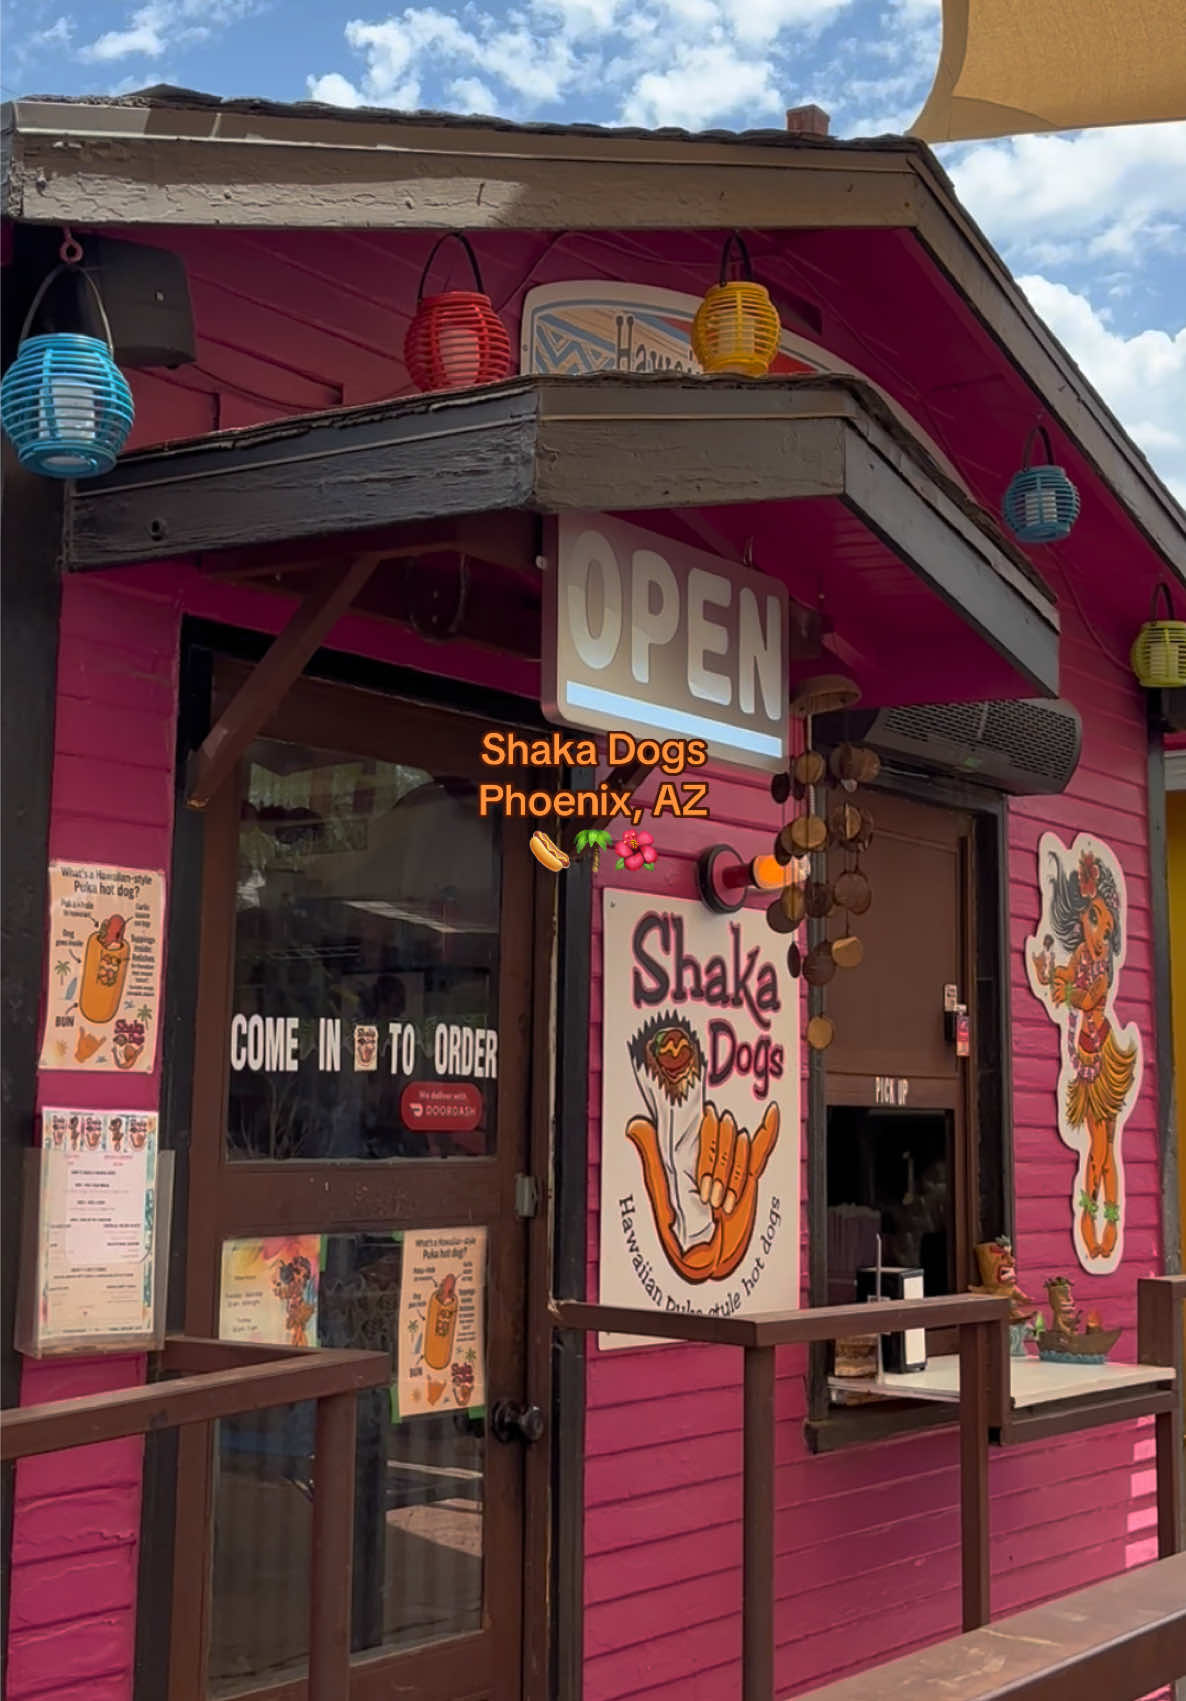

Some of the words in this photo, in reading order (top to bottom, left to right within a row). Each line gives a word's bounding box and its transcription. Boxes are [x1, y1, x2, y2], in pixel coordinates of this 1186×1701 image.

[567, 530, 782, 721] OPEN
[632, 911, 782, 1031] Shaka
[231, 1014, 299, 1071] COME
[319, 1018, 341, 1072] IN
[389, 1022, 416, 1076] TO
[434, 1023, 498, 1079] ORDER
[708, 1018, 784, 1101] Dogs
[425, 1104, 477, 1117] DOORDASH
[875, 1076, 895, 1105] PICK
[897, 1078, 909, 1105] UP
[619, 1192, 663, 1307] Hawaiian
[741, 1256, 766, 1297] hot
[760, 1196, 782, 1256] dogs
